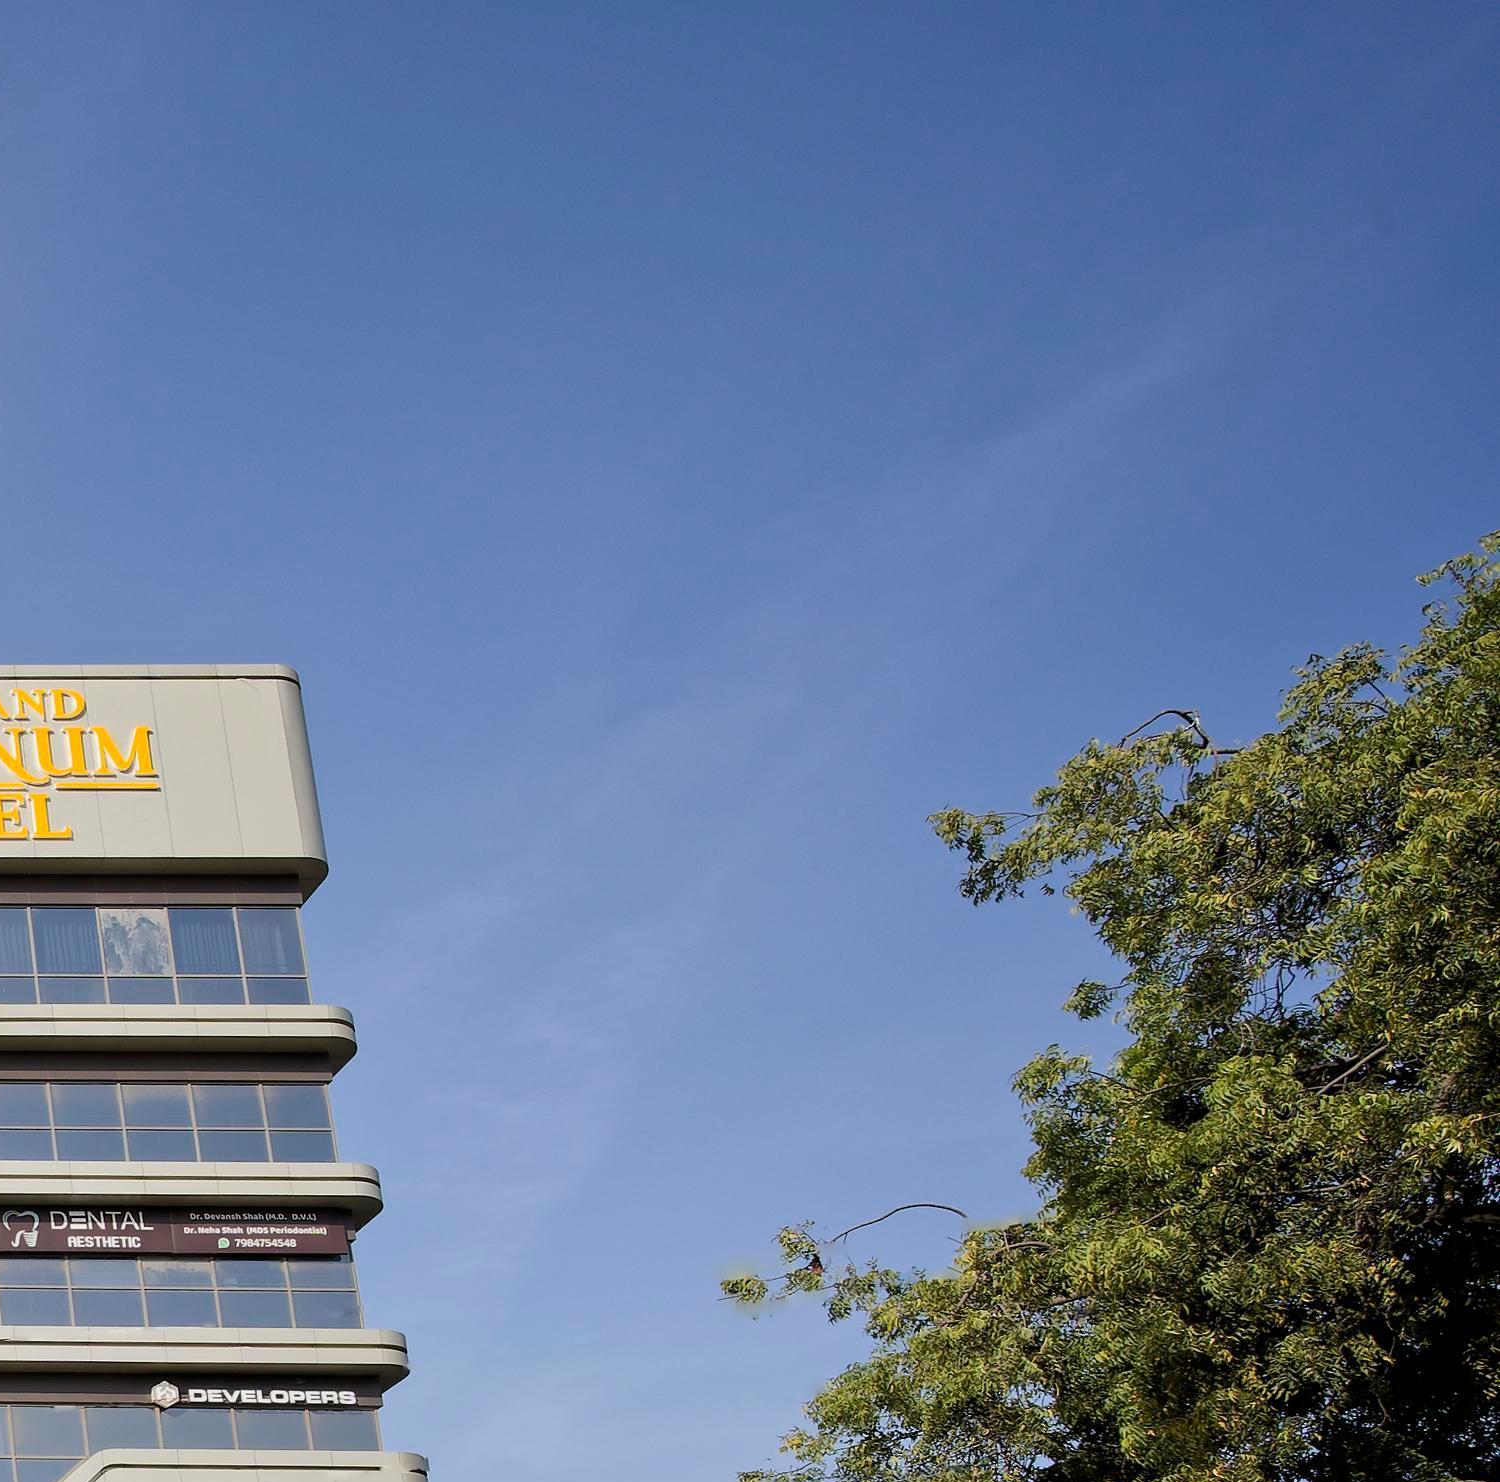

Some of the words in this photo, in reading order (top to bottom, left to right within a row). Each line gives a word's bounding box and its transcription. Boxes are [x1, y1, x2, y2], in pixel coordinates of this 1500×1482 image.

[49, 1211, 154, 1231] DENTAL
[67, 1236, 141, 1248] AESTHETIC
[187, 1388, 357, 1405] DEVELOPERS
